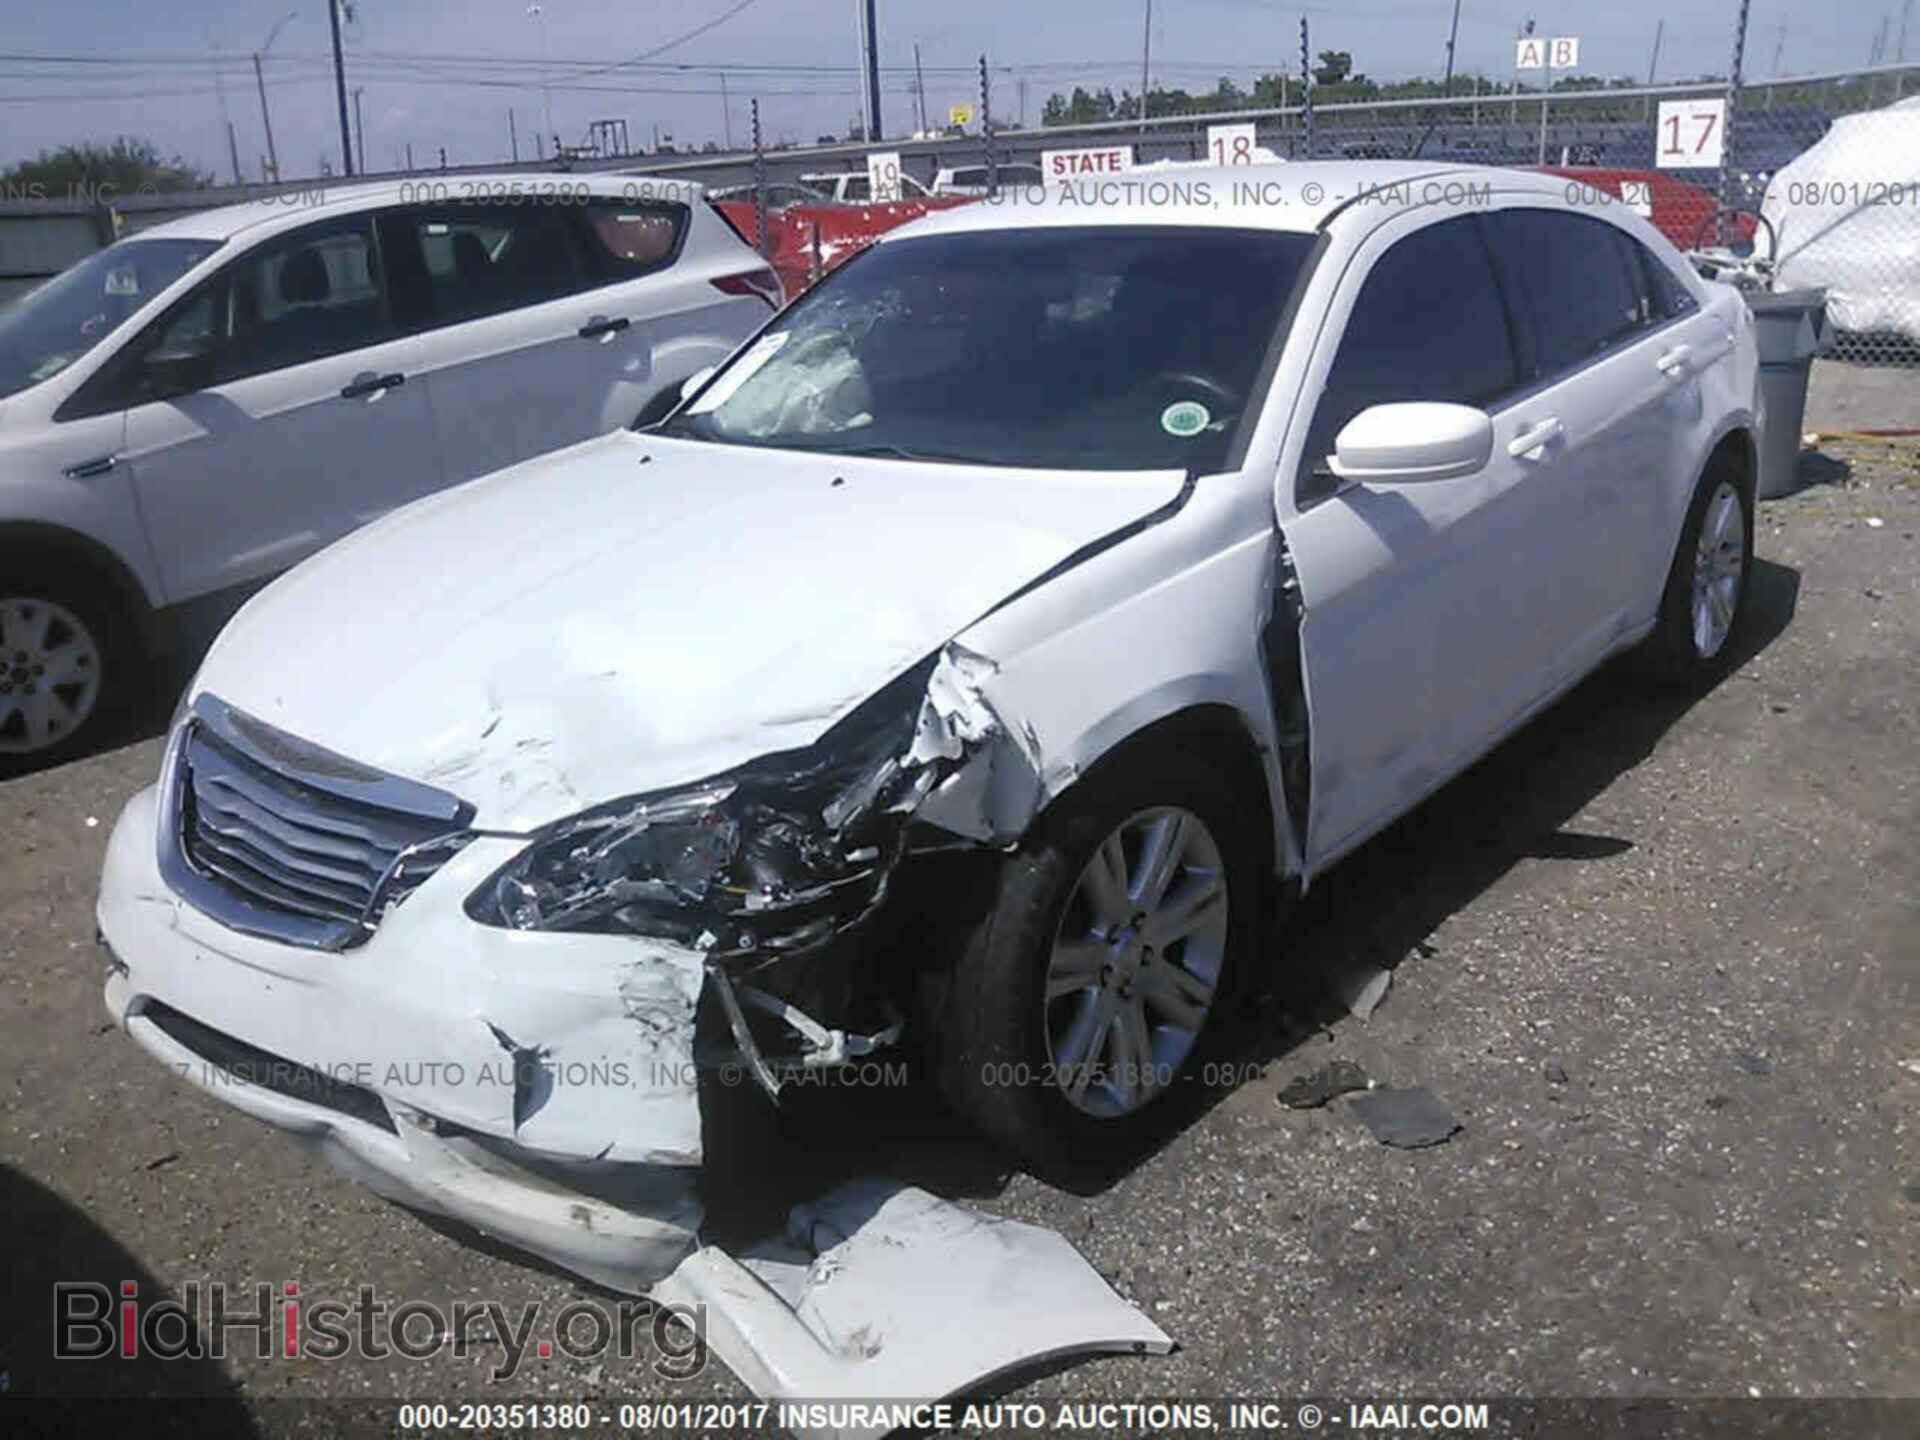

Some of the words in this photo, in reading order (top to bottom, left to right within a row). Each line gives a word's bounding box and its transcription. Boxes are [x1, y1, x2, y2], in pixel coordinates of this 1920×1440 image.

[1521, 42, 1539, 65] A
[1556, 40, 1572, 65] B
[1662, 114, 1718, 155] 17
[1052, 151, 1122, 175] STATE
[1212, 136, 1251, 167] 18
[871, 162, 898, 191] 19
